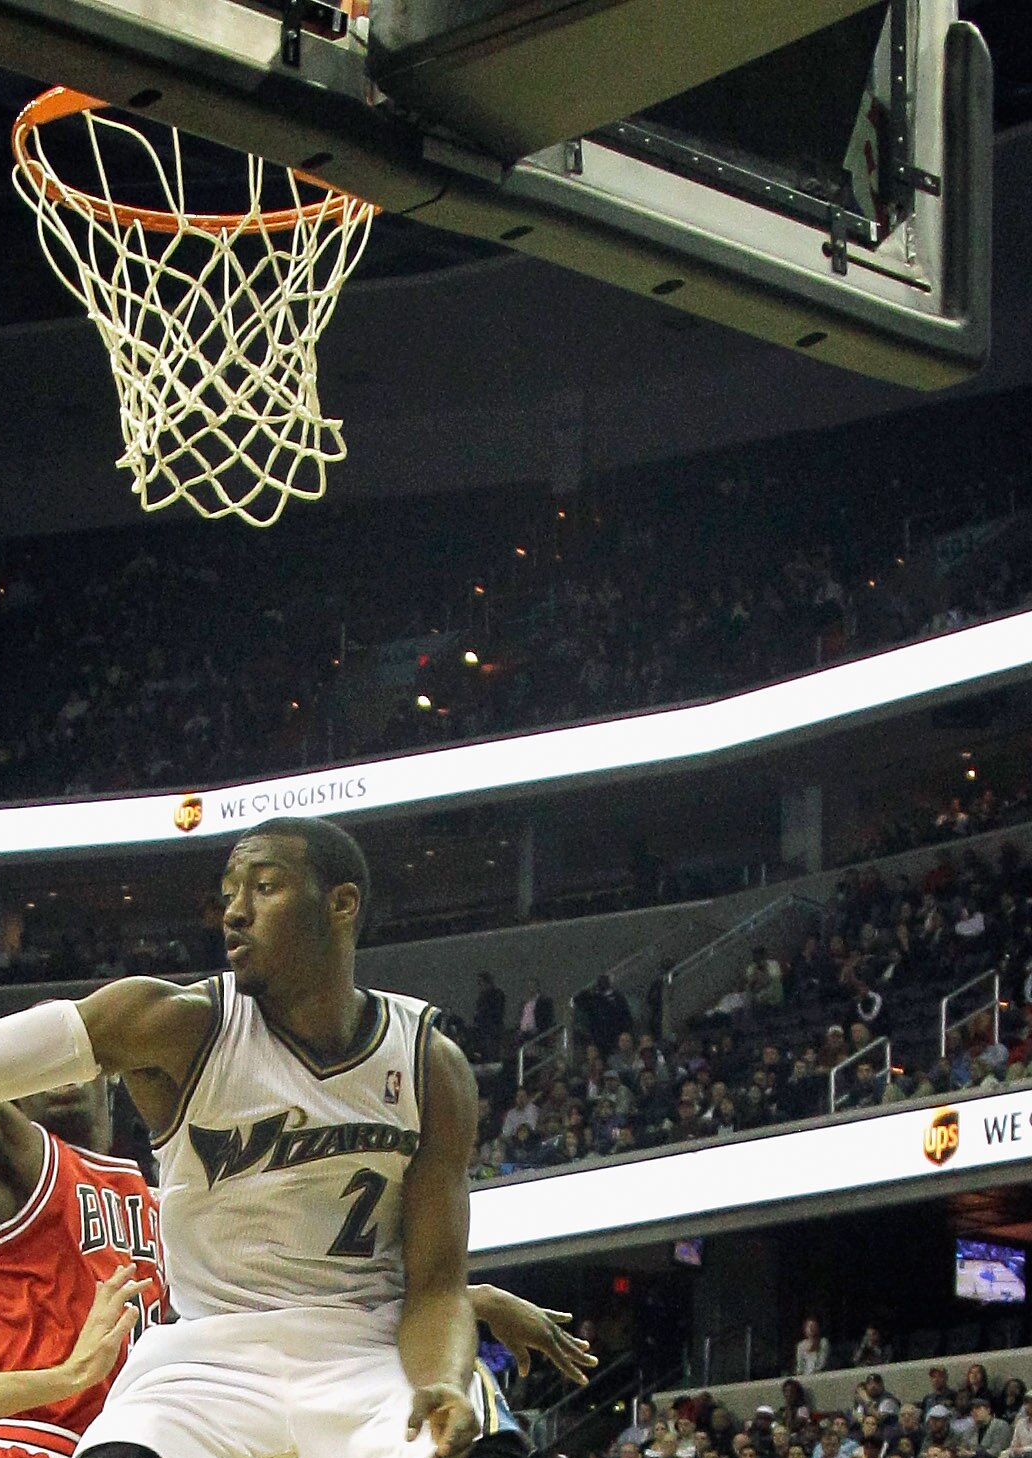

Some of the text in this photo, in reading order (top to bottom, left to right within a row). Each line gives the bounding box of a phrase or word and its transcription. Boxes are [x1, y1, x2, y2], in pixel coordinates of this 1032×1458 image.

[220, 798, 247, 820] WE
[273, 776, 367, 812] LOGISTICS
[924, 1111, 1022, 1160] ups WE
[325, 1167, 389, 1258] 2
